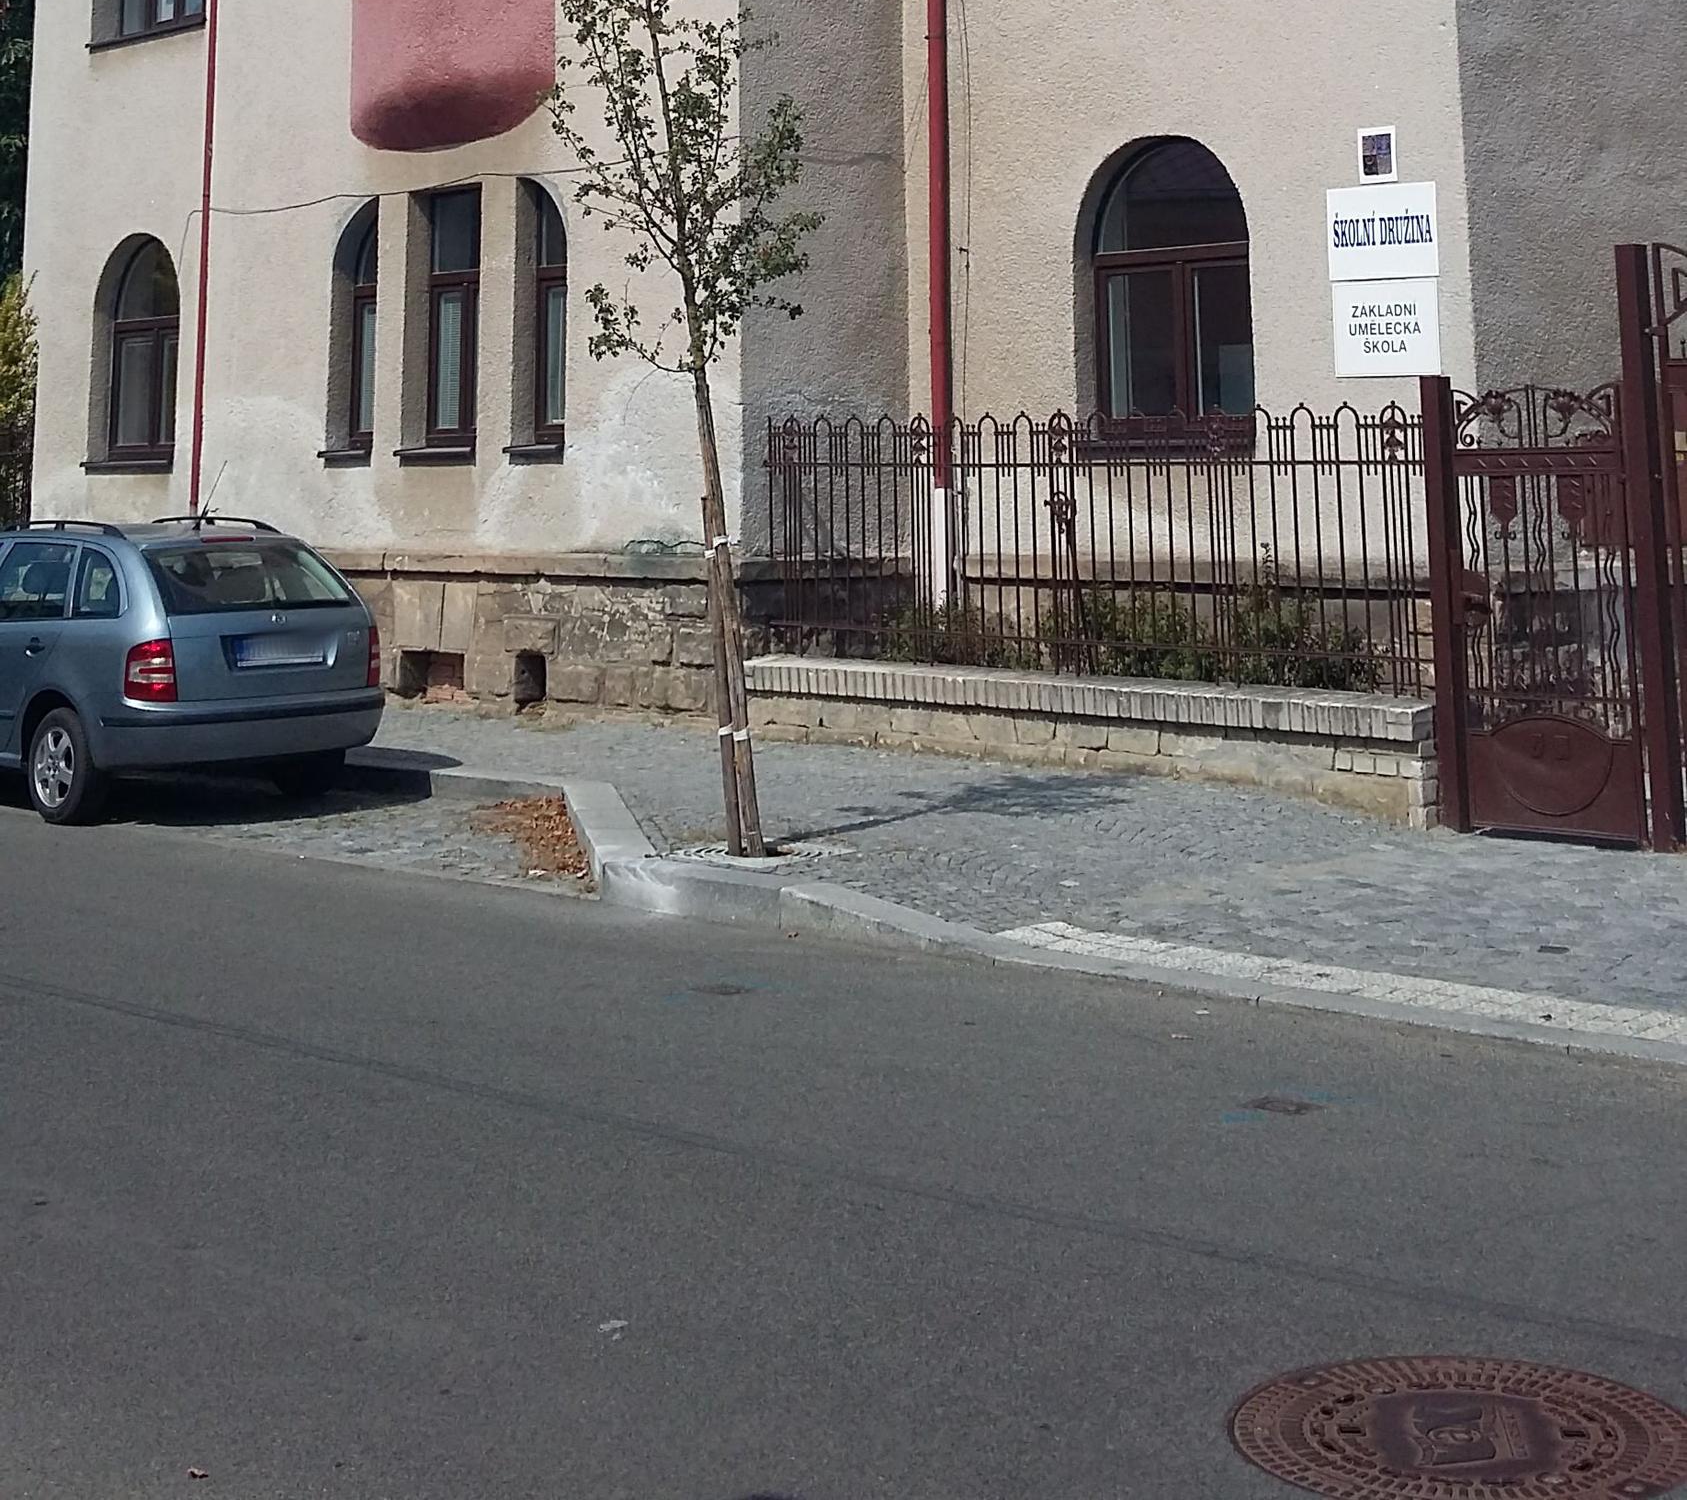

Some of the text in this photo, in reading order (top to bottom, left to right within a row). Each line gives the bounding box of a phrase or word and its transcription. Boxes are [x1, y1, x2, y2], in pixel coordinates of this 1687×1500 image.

[1333, 208, 1433, 248] ŠKOLNÍ DRUŽINA
[1363, 337, 1407, 353] ŠKOLA
